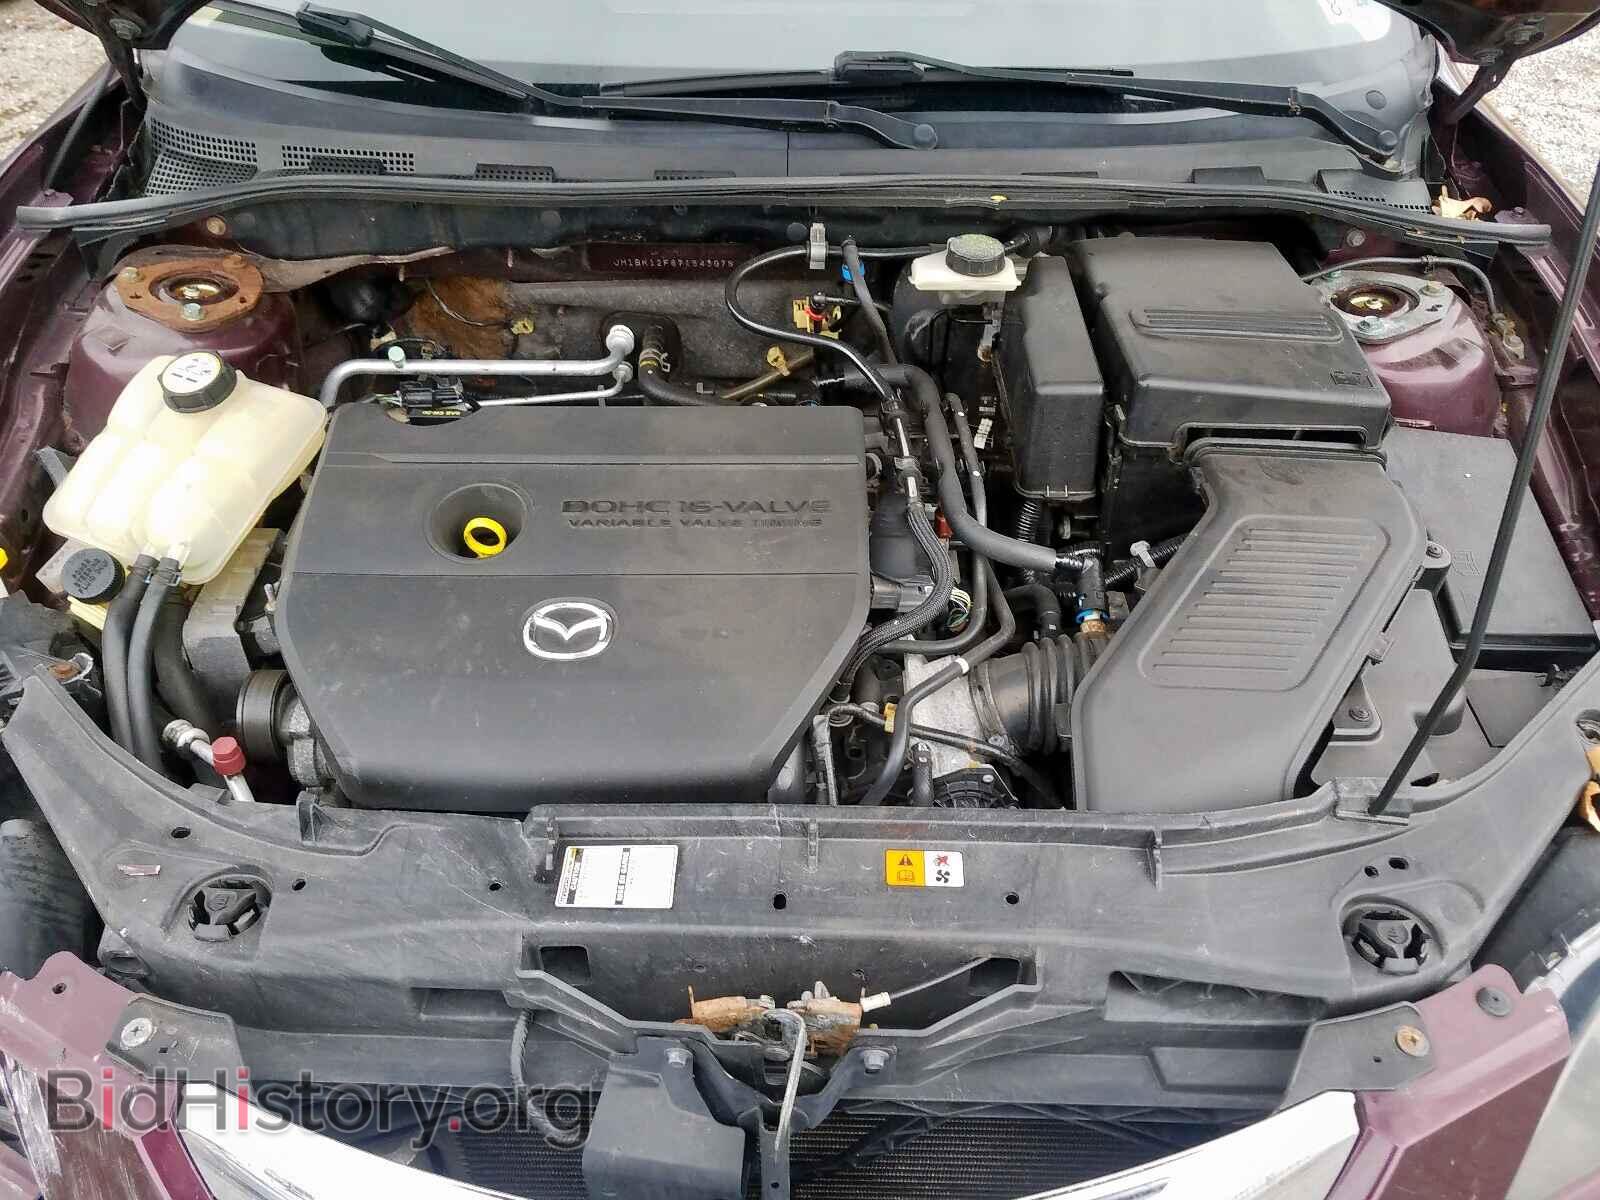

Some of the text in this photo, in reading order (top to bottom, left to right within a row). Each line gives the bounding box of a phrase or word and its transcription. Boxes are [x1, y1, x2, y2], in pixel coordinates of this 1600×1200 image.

[562, 500, 830, 513] DOHC 16-VALVE
[568, 519, 672, 529] VARIABLE
[680, 519, 745, 529] VALVE
